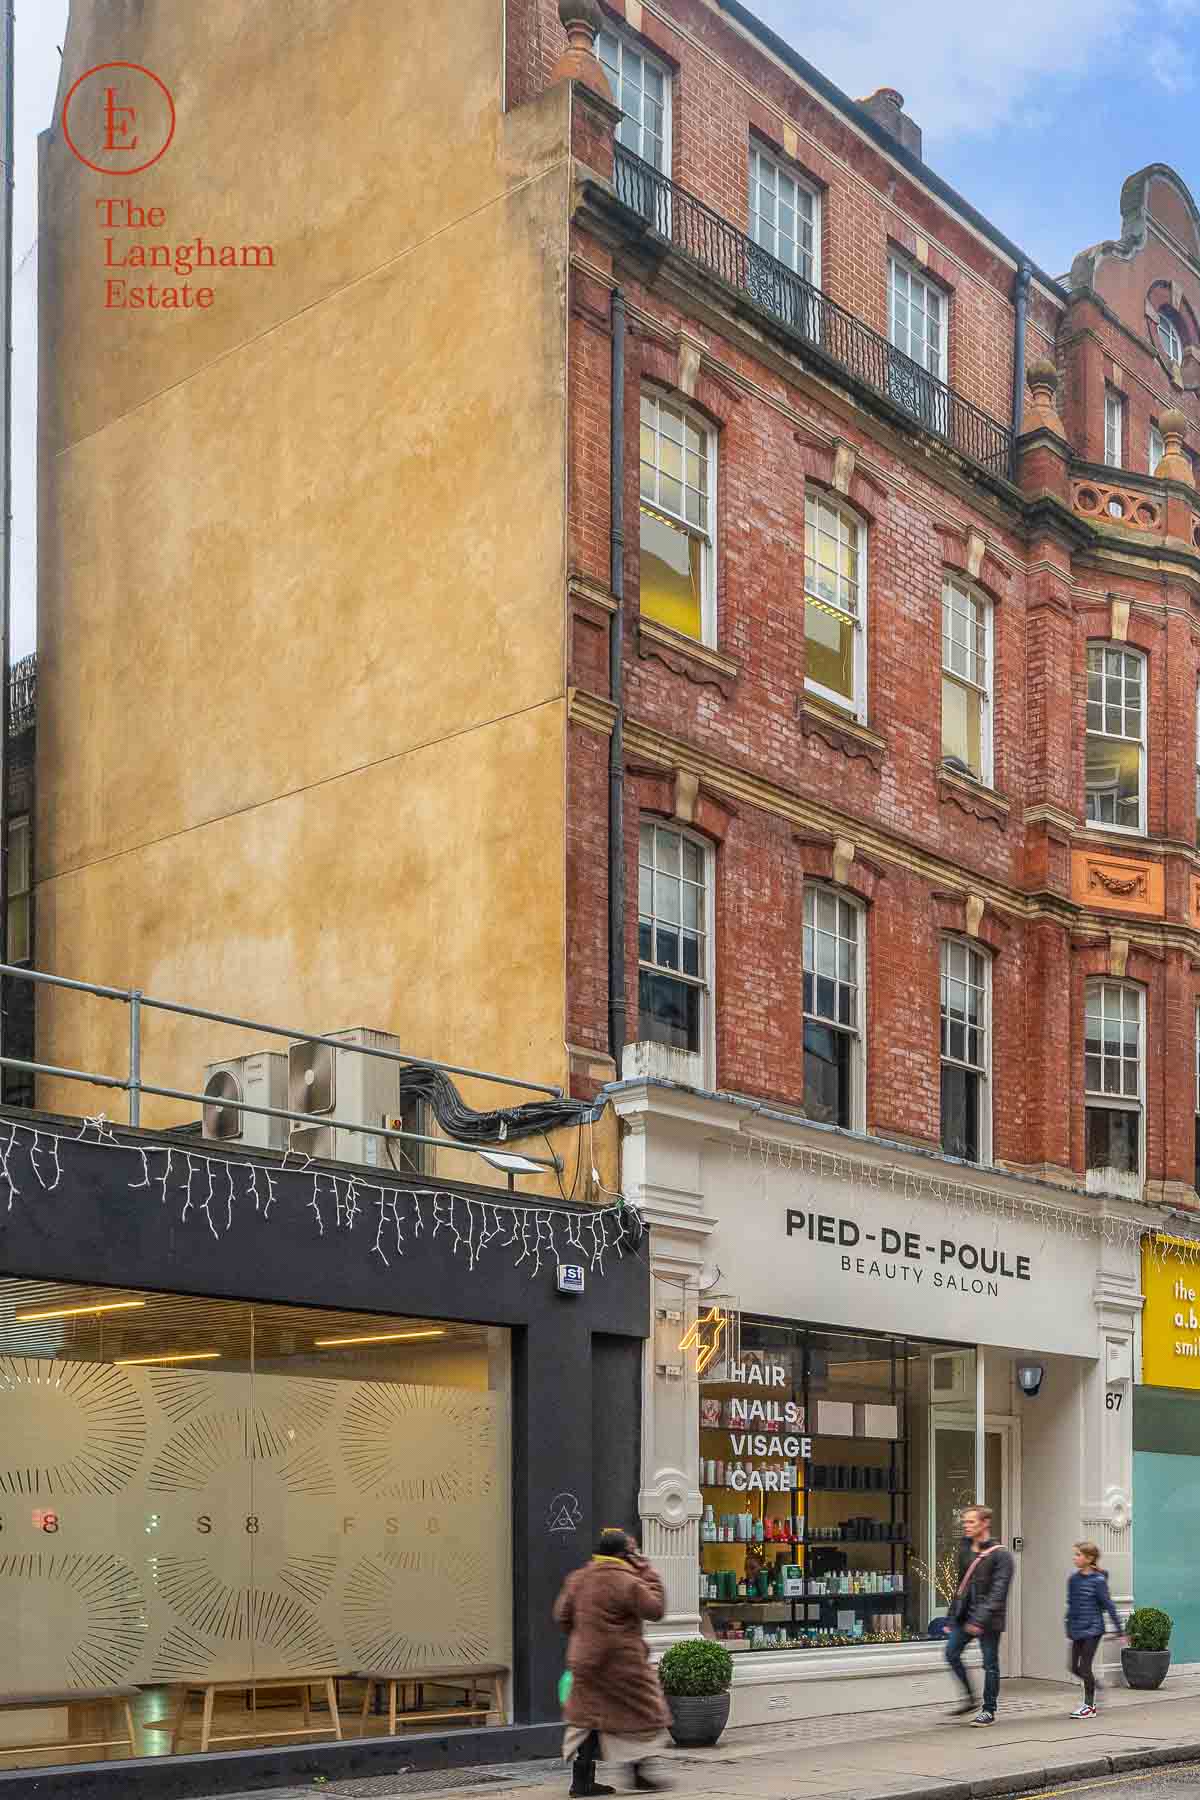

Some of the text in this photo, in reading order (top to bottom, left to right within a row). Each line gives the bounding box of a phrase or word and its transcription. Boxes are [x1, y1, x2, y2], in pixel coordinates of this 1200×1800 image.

[786, 1208, 1031, 1281] PIED-DE-POULE
[841, 1256, 998, 1297] BEAUTY SALON
[1175, 1277, 1196, 1301] the
[731, 1361, 785, 1387] HAIR
[731, 1398, 797, 1423] NAILS
[1105, 1392, 1122, 1412] 67
[730, 1434, 812, 1458] VISAGE
[731, 1469, 791, 1492] CARE
